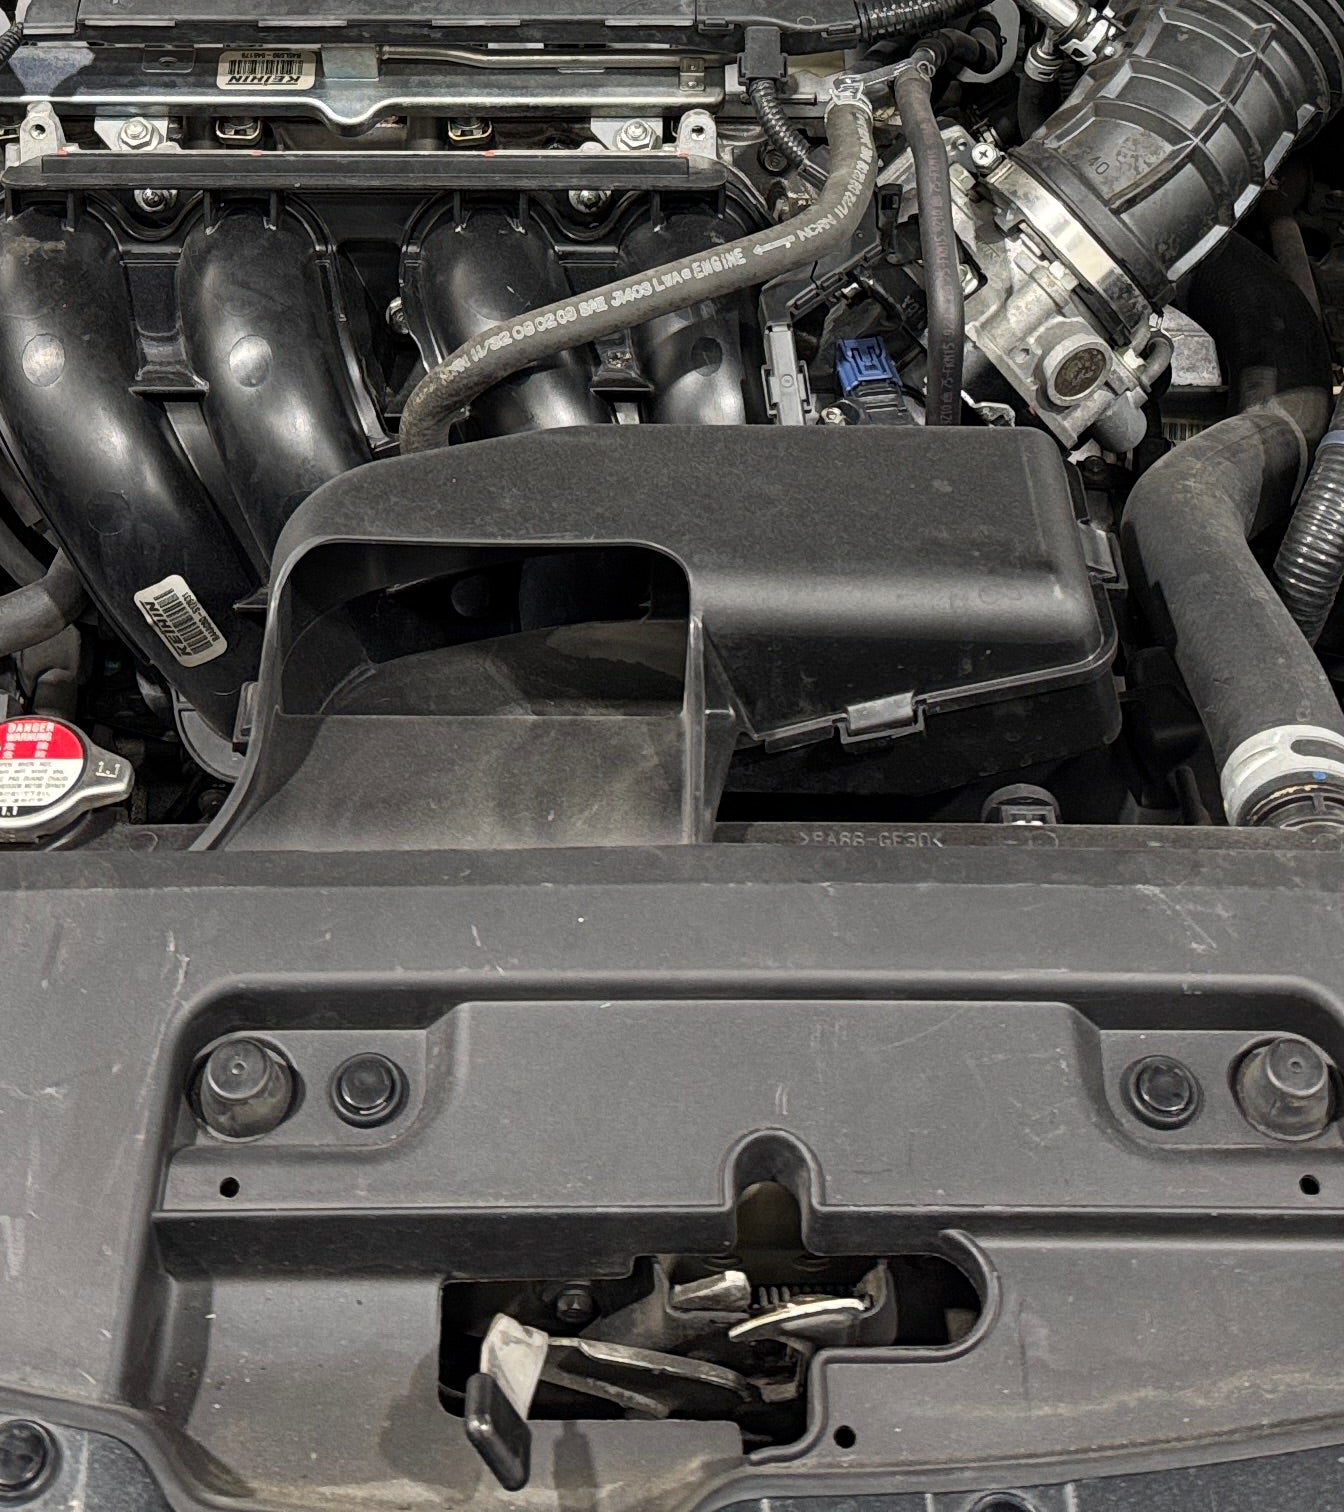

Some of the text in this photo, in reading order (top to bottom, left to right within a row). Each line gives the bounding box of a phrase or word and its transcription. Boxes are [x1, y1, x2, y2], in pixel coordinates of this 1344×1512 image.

[228, 76, 301, 84] KEIHIN
[691, 248, 748, 280] ENGINE
[143, 601, 193, 656] KEIHIN
[7, 722, 55, 734] DANGER
[6, 732, 53, 742] WARNING
